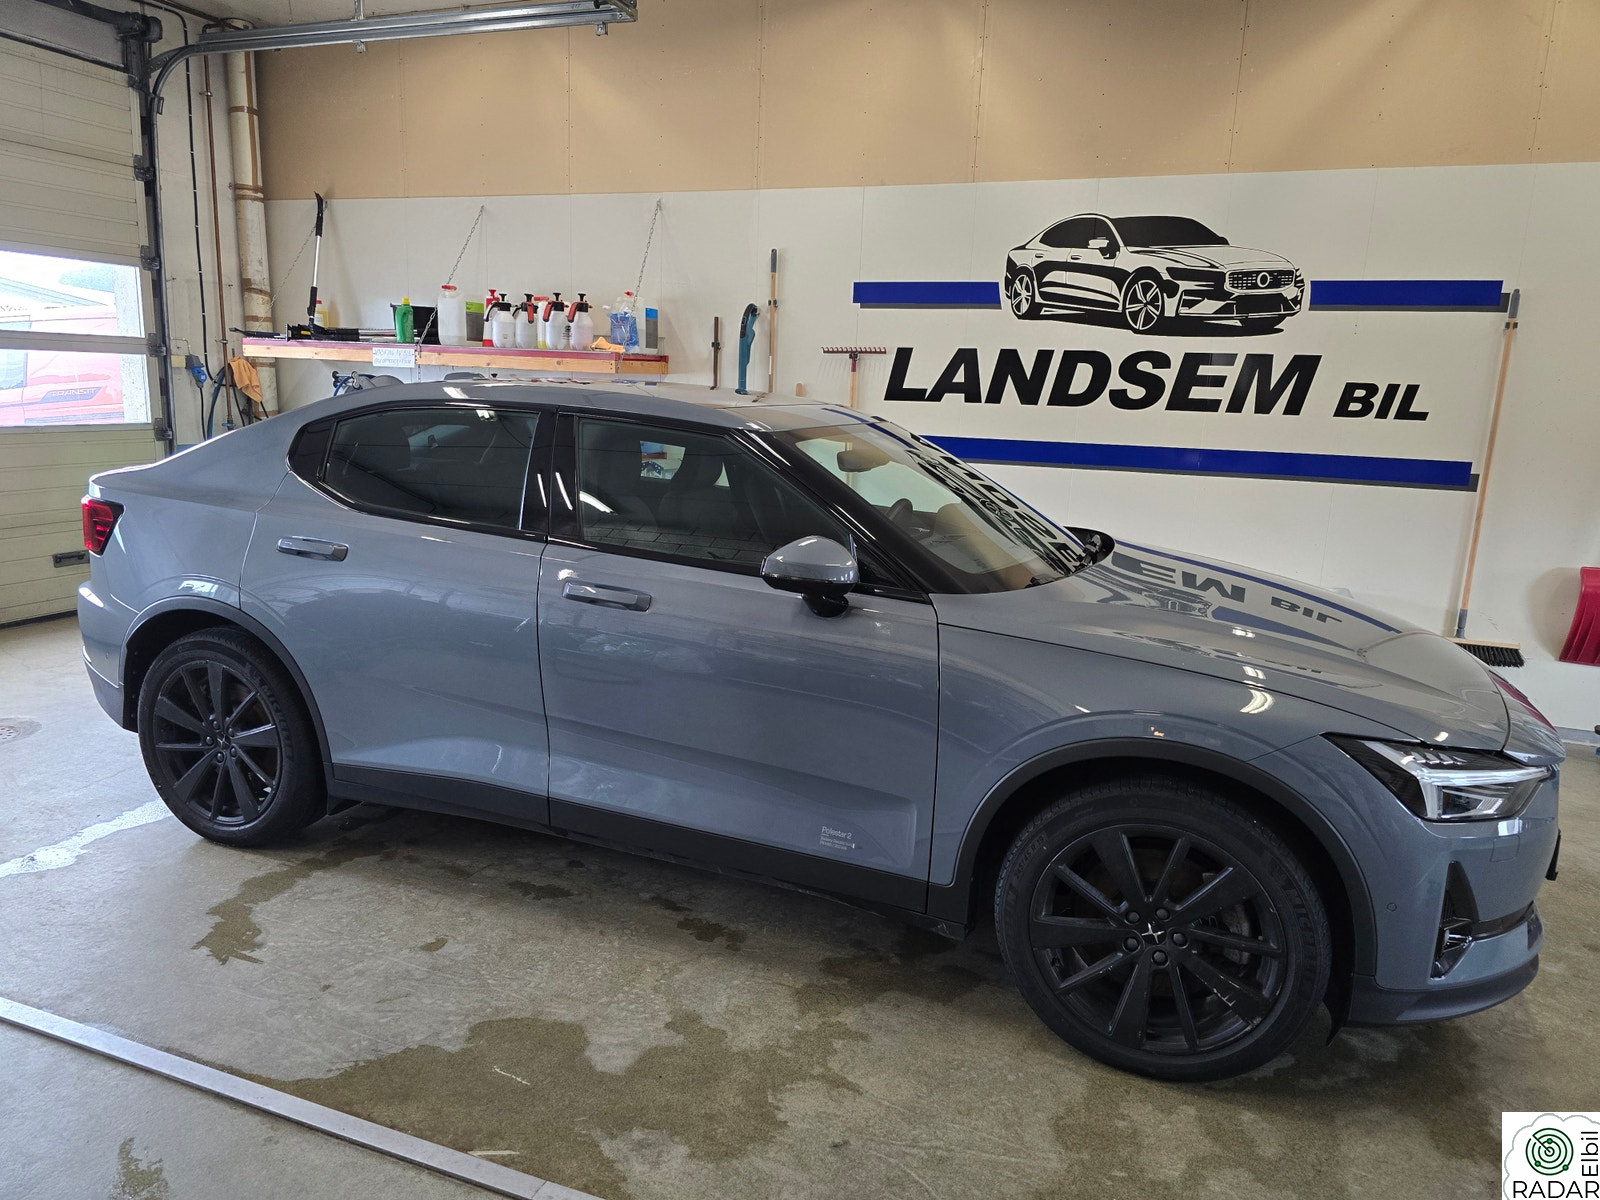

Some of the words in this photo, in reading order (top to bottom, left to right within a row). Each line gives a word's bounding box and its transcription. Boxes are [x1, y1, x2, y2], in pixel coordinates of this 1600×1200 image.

[884, 346, 1322, 416] LANDSEM
[1333, 381, 1430, 422] BIL
[50, 387, 97, 397] TRANSIT
[821, 826, 847, 838] Polestar
[847, 832, 853, 840] 2
